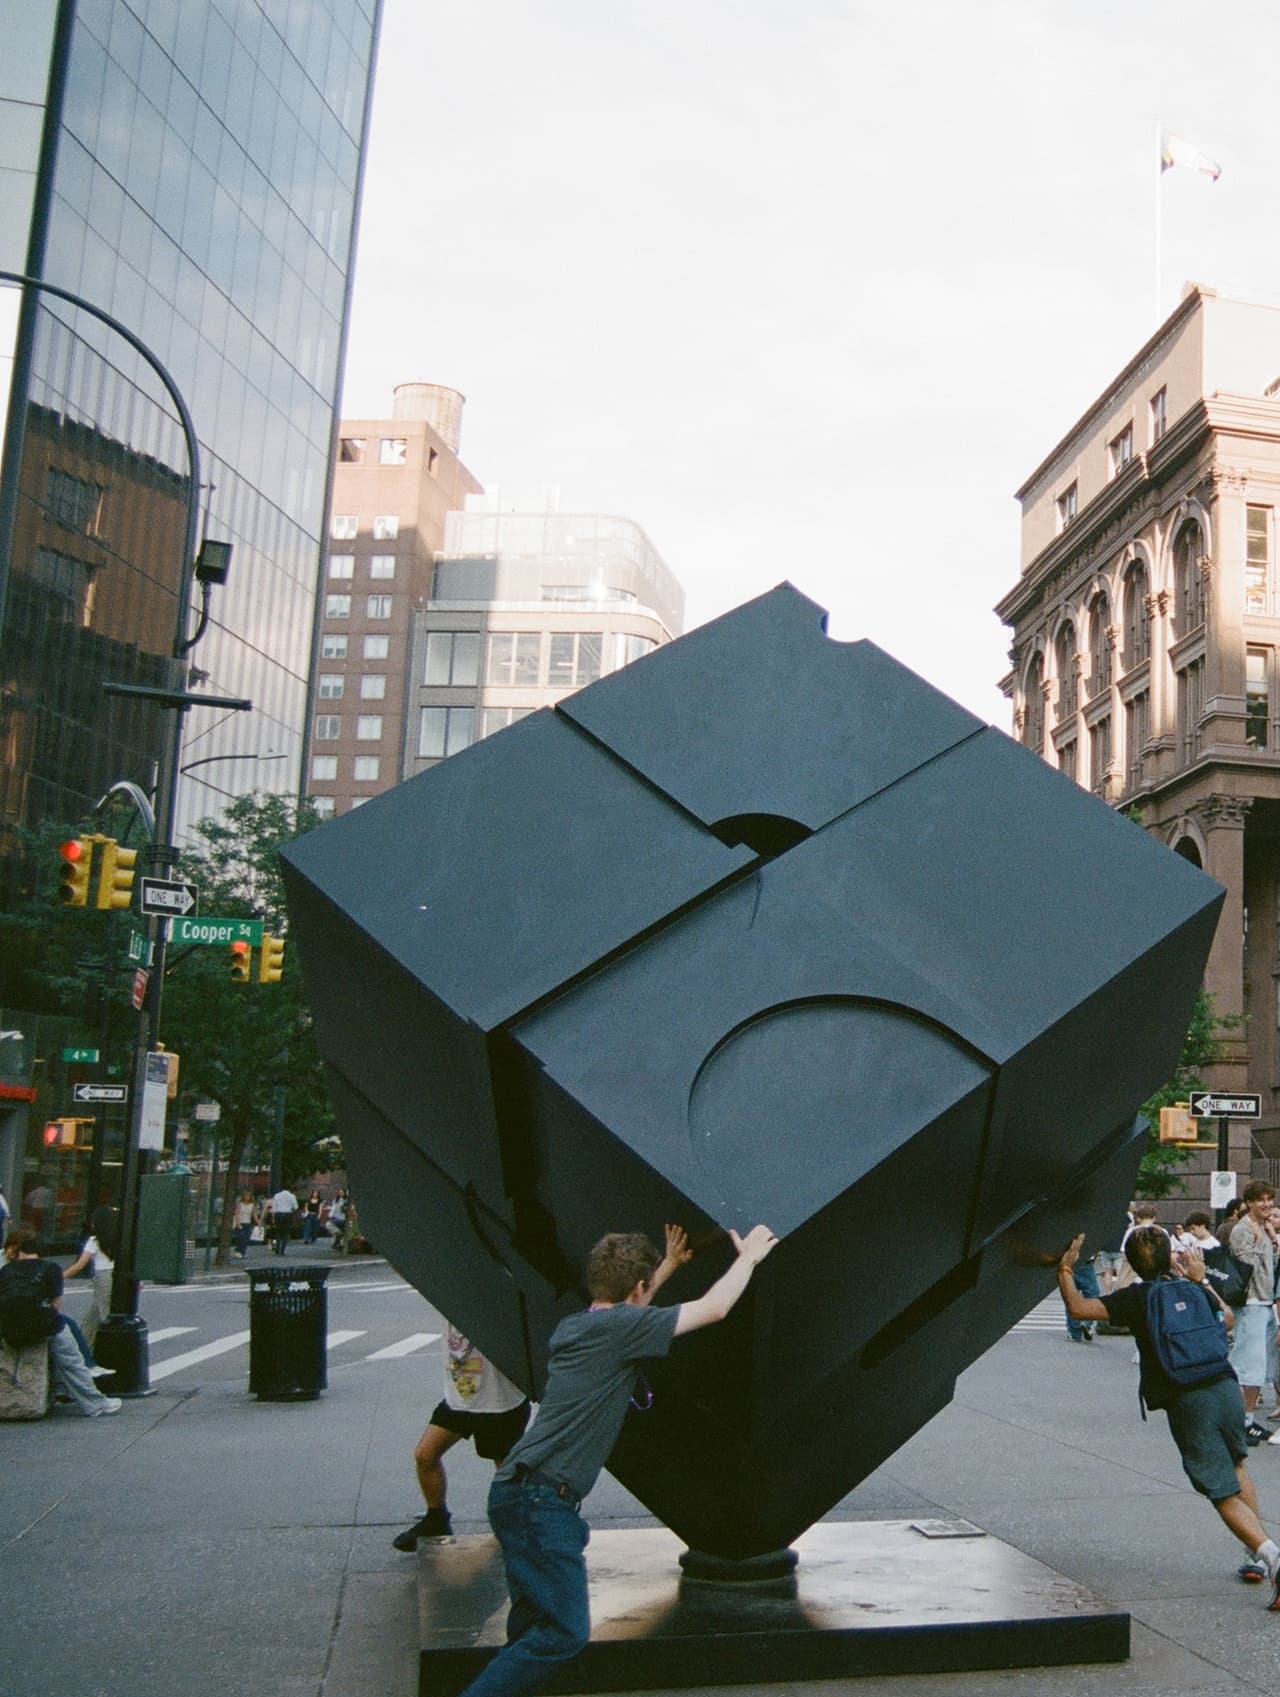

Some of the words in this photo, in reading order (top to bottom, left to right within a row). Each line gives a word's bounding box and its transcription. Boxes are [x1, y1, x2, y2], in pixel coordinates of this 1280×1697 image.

[151, 890, 167, 904] ONE
[174, 893, 191, 906] WAY
[181, 921, 234, 943] Cooper
[239, 923, 251, 937] Sq
[72, 1050, 80, 1061] 4
[1201, 1099, 1221, 1110] ONE
[1231, 1100, 1250, 1110] WAY
